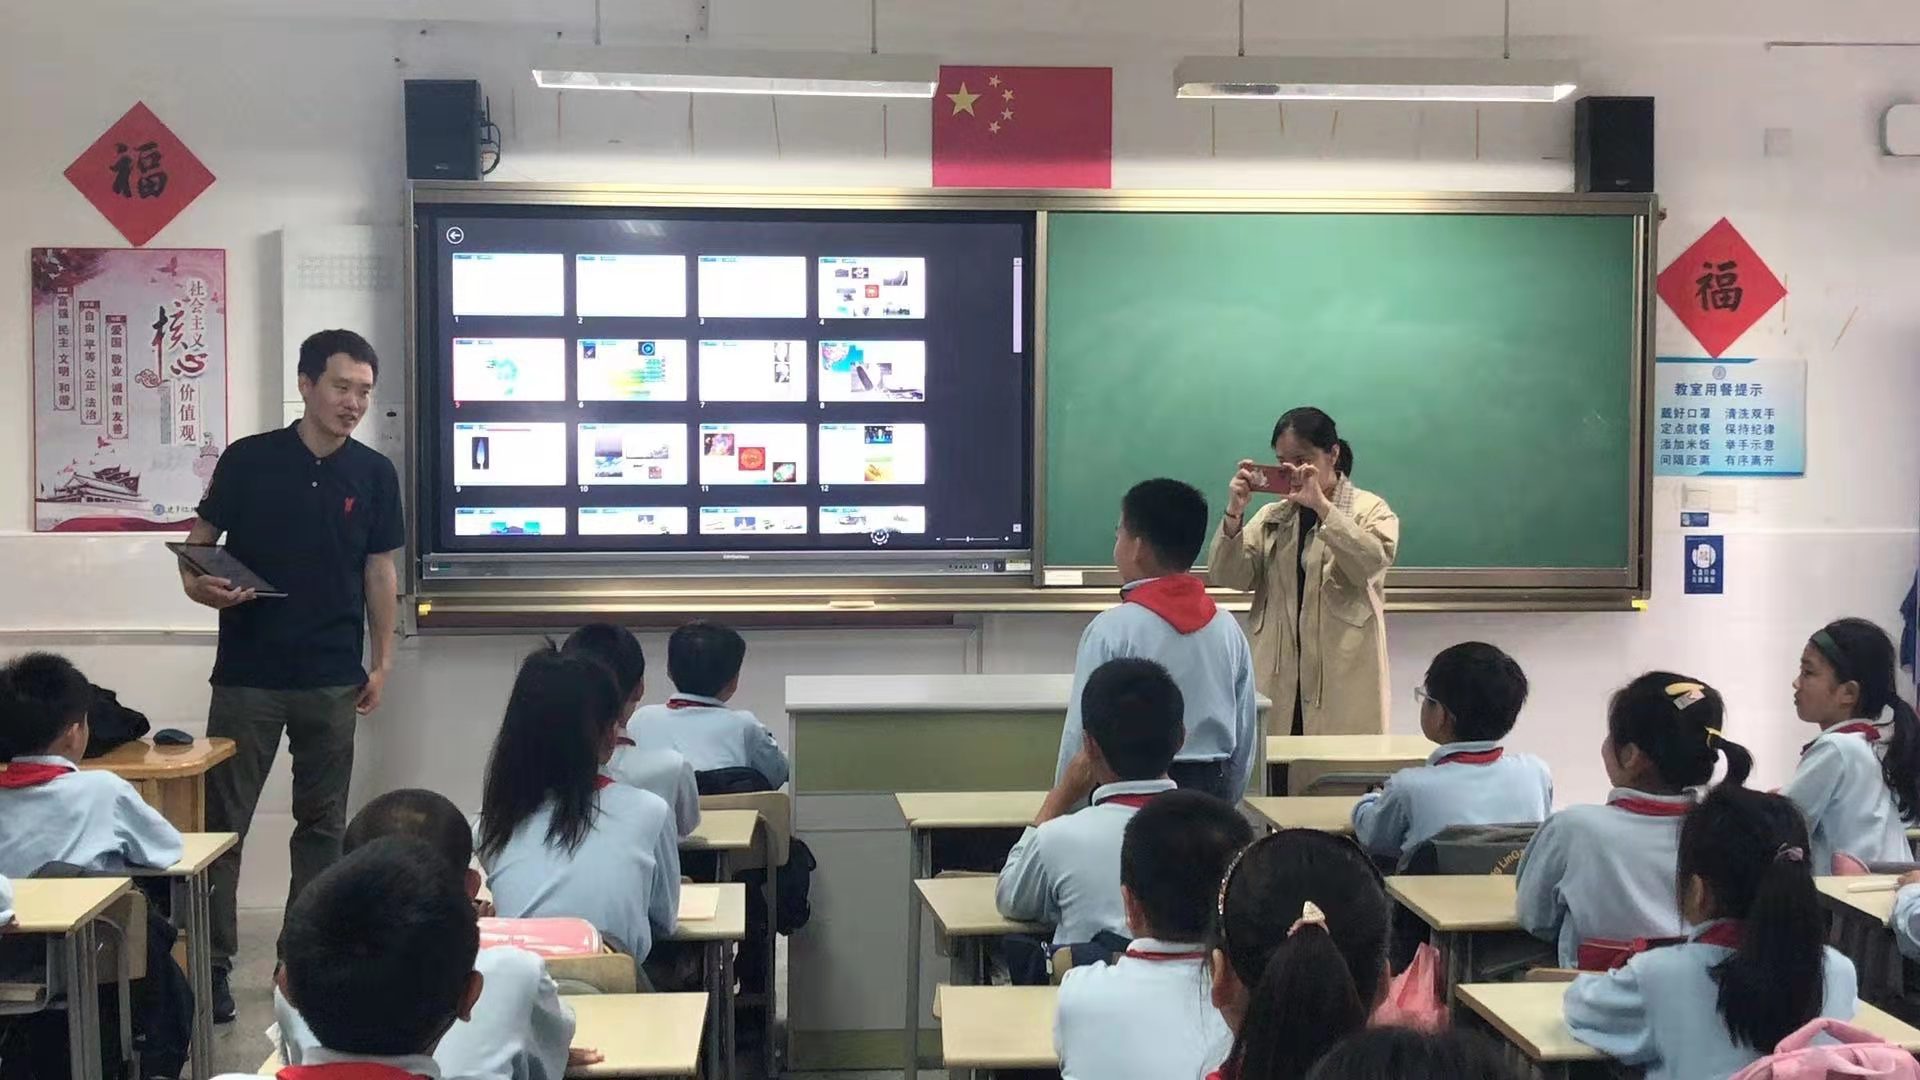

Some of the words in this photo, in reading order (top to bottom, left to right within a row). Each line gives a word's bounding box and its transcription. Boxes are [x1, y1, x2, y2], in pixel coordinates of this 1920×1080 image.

[110, 142, 168, 199] 福
[1694, 260, 1744, 313] 福
[85, 310, 95, 333] 自由
[189, 280, 205, 348] 社会主义
[58, 324, 69, 348] 民主
[110, 325, 122, 348] 爱国
[152, 301, 208, 381] 核心
[84, 339, 96, 363] 平等
[58, 353, 70, 377] 文明
[111, 354, 122, 377] 敬业
[85, 368, 96, 391] 公正
[1674, 383, 1763, 397] 教室用餐提示
[58, 383, 70, 406] 和谐
[111, 383, 123, 406] 诚信
[455, 401, 461, 409] 5
[85, 397, 97, 420] 法治
[179, 383, 196, 442] 价值观
[1661, 407, 1711, 419] 戴好口罩
[1725, 408, 1775, 420] 清洗双手
[112, 411, 123, 435] 友善
[1660, 422, 1711, 435] 定点就餐
[1725, 423, 1775, 435] 保持纪律
[1660, 439, 1710, 450] 添加米饭
[1725, 439, 1775, 451] 举手示意
[1660, 454, 1711, 466] 间隔距离
[1725, 455, 1775, 466] 有序离开
